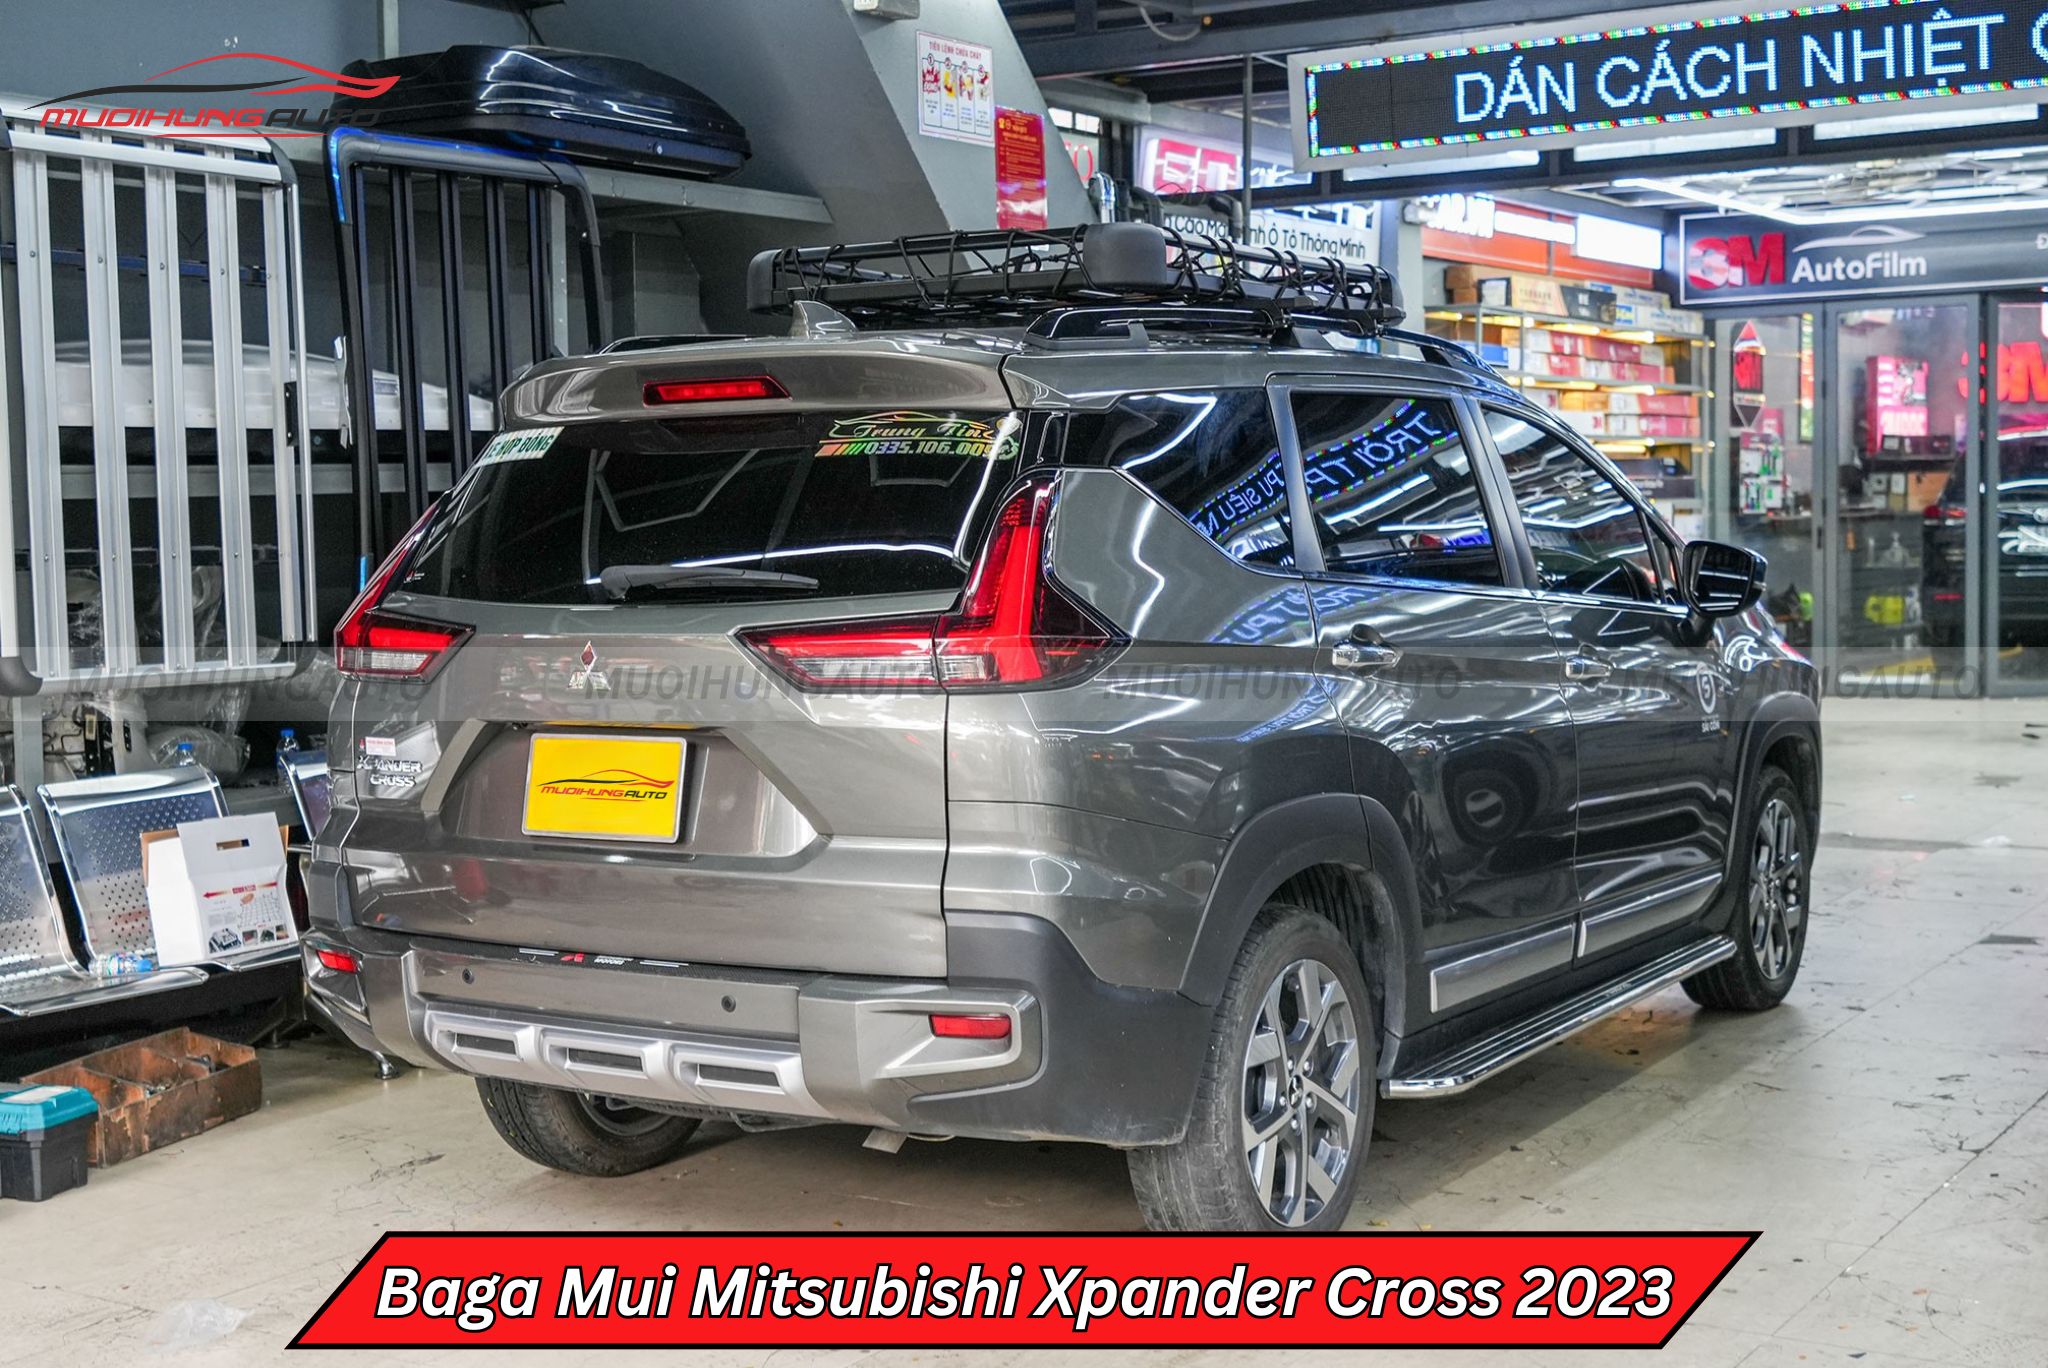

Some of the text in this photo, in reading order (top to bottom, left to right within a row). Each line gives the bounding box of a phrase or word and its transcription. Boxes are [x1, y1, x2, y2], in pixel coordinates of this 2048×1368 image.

[1454, 55, 1577, 124] DÁN
[1596, 40, 1778, 109] CÁCH
[1802, 7, 2006, 88] NHIỆT
[1686, 232, 1787, 290] 3M
[1791, 252, 1928, 284] AutoFilm
[357, 755, 422, 773] XANDER
[370, 774, 416, 787] CROSS
